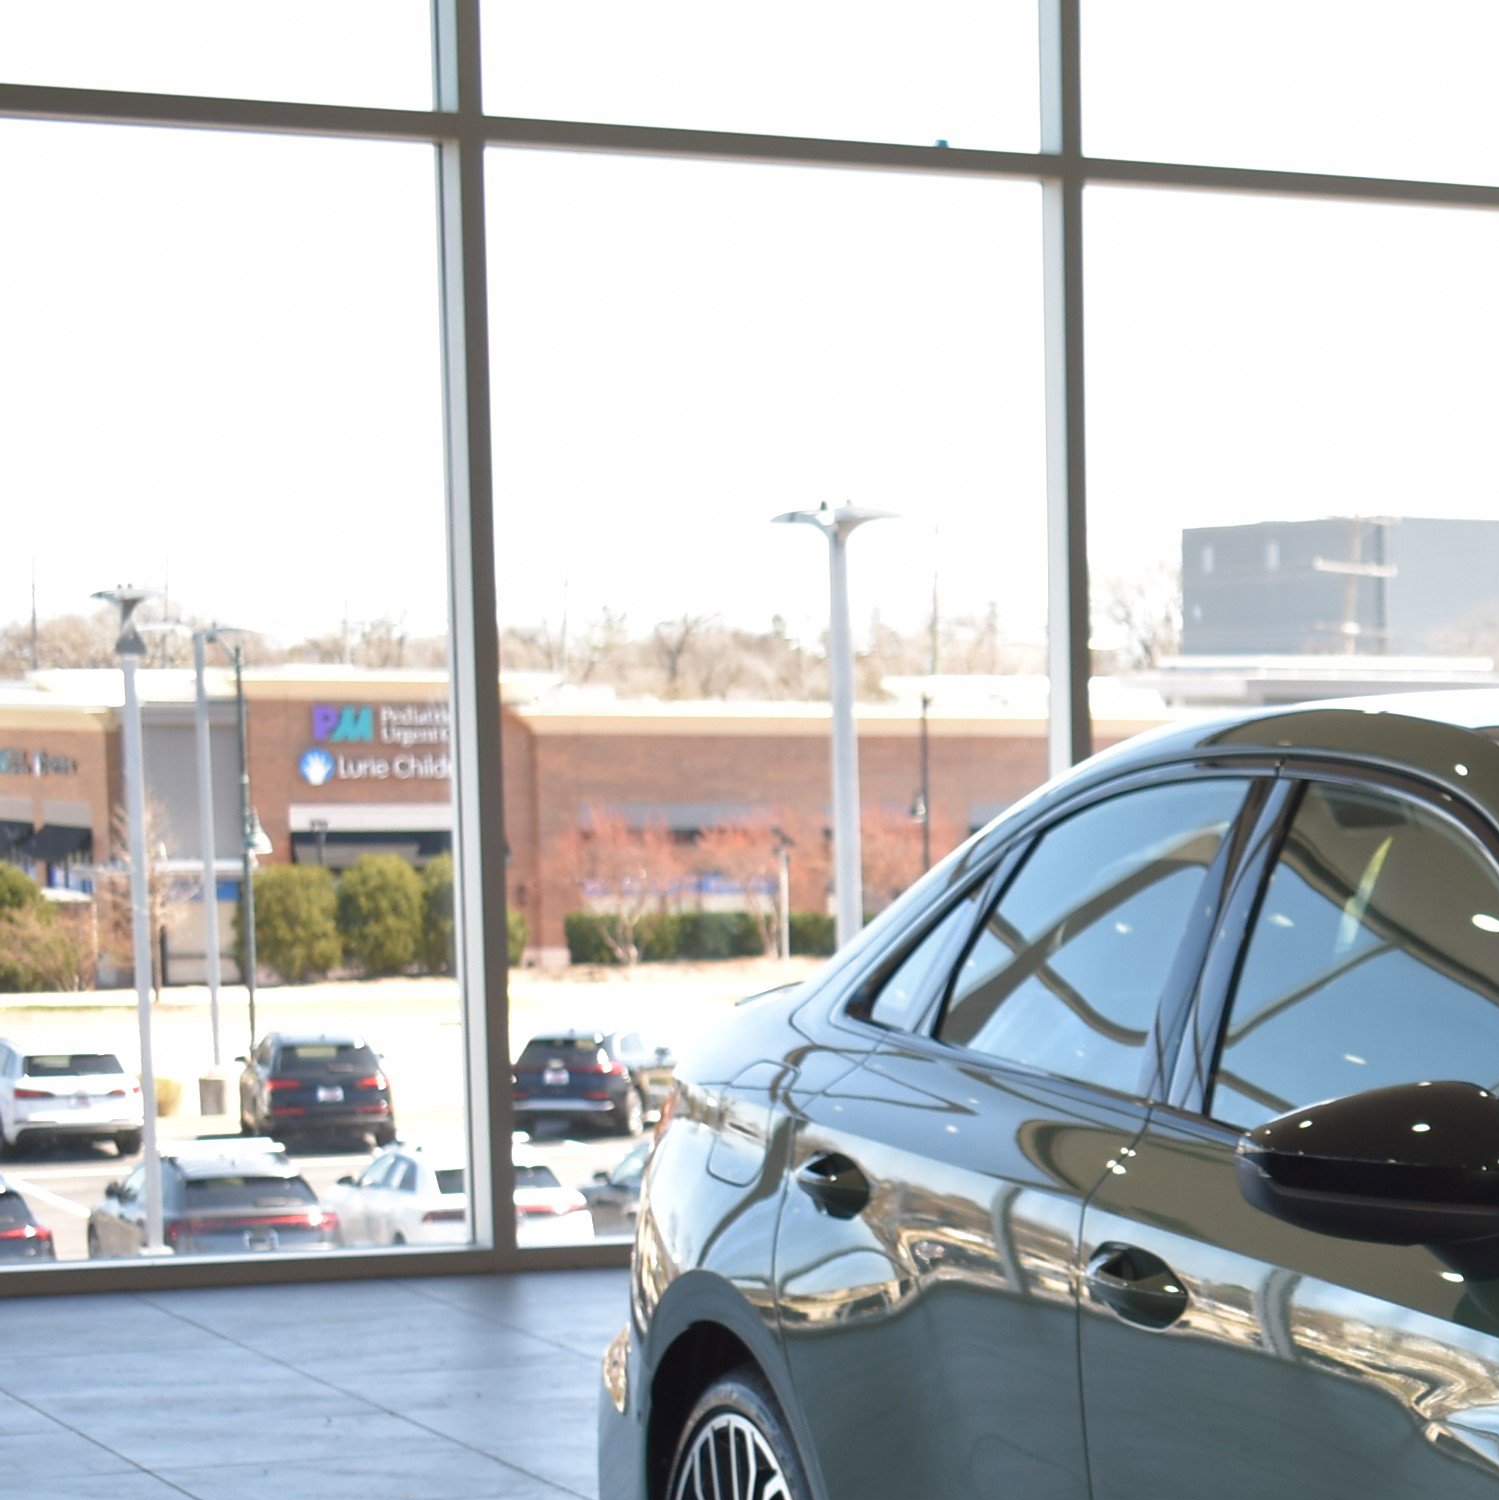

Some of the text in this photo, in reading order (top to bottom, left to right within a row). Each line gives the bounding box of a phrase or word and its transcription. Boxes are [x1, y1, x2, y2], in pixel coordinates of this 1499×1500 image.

[380, 704, 450, 723] Pediatri
[338, 753, 451, 780] Lurie Child
